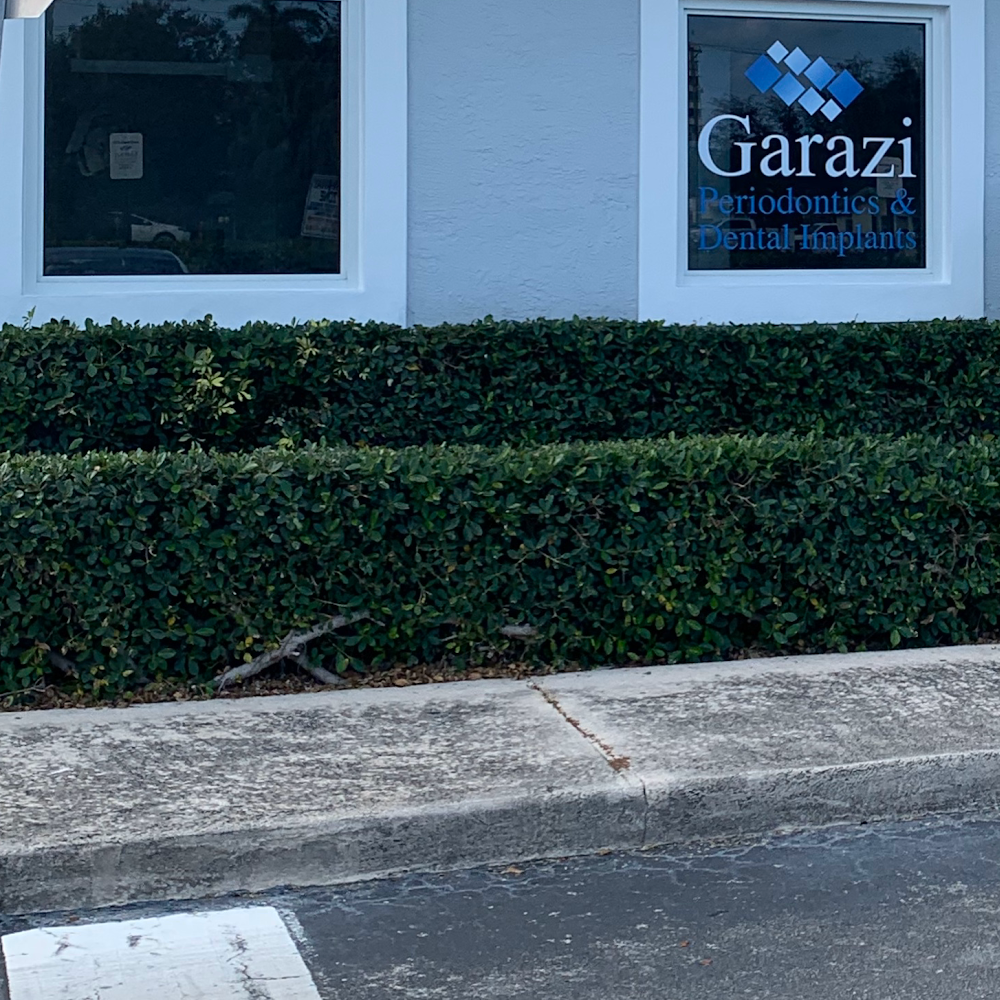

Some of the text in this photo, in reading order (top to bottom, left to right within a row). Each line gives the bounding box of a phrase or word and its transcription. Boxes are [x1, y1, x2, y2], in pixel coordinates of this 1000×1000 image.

[697, 114, 917, 178] Garazi
[698, 186, 916, 215] Periodontics &
[697, 224, 917, 257] Dental Implants
